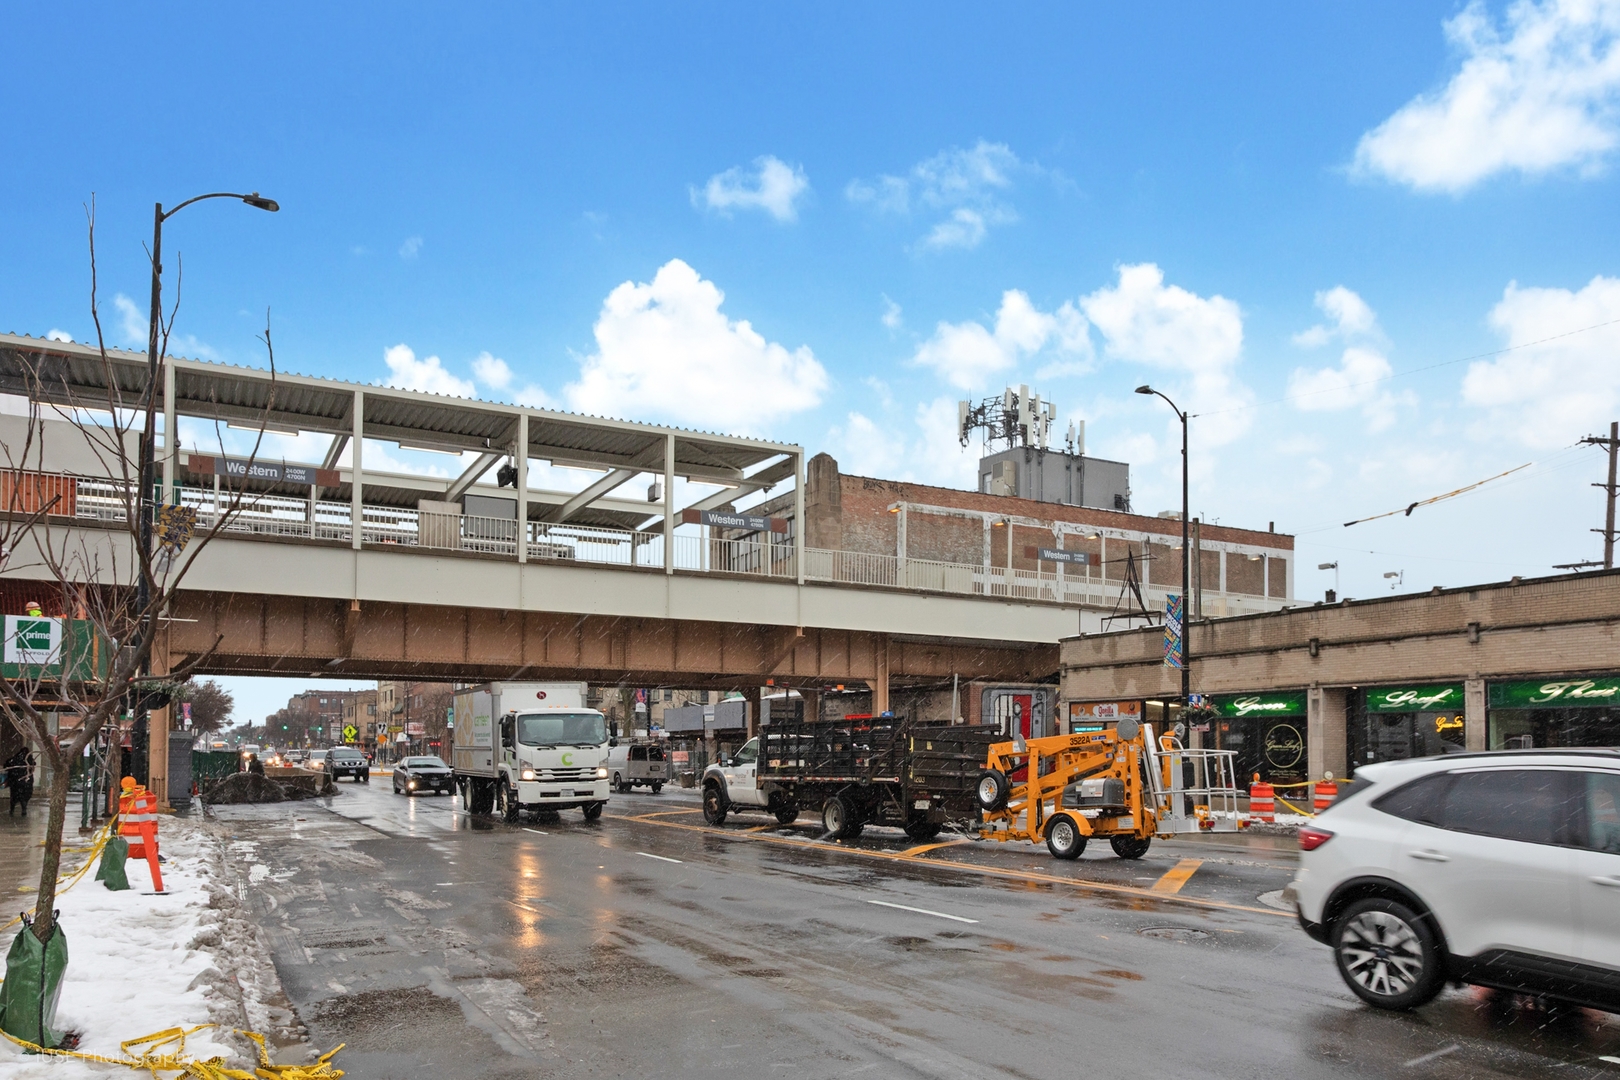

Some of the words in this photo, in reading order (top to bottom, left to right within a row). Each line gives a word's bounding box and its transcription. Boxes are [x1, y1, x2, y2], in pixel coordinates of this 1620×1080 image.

[226, 461, 278, 478] Western
[285, 467, 306, 475] 2400W
[286, 473, 306, 481] 4700N
[708, 513, 745, 526] Western
[1043, 549, 1071, 560] Western
[26, 631, 50, 640] prime
[1529, 679, 1619, 703] Thai
[1379, 688, 1454, 709] Leaf
[1233, 696, 1291, 716] Green
[1069, 736, 1091, 746] 3522A
